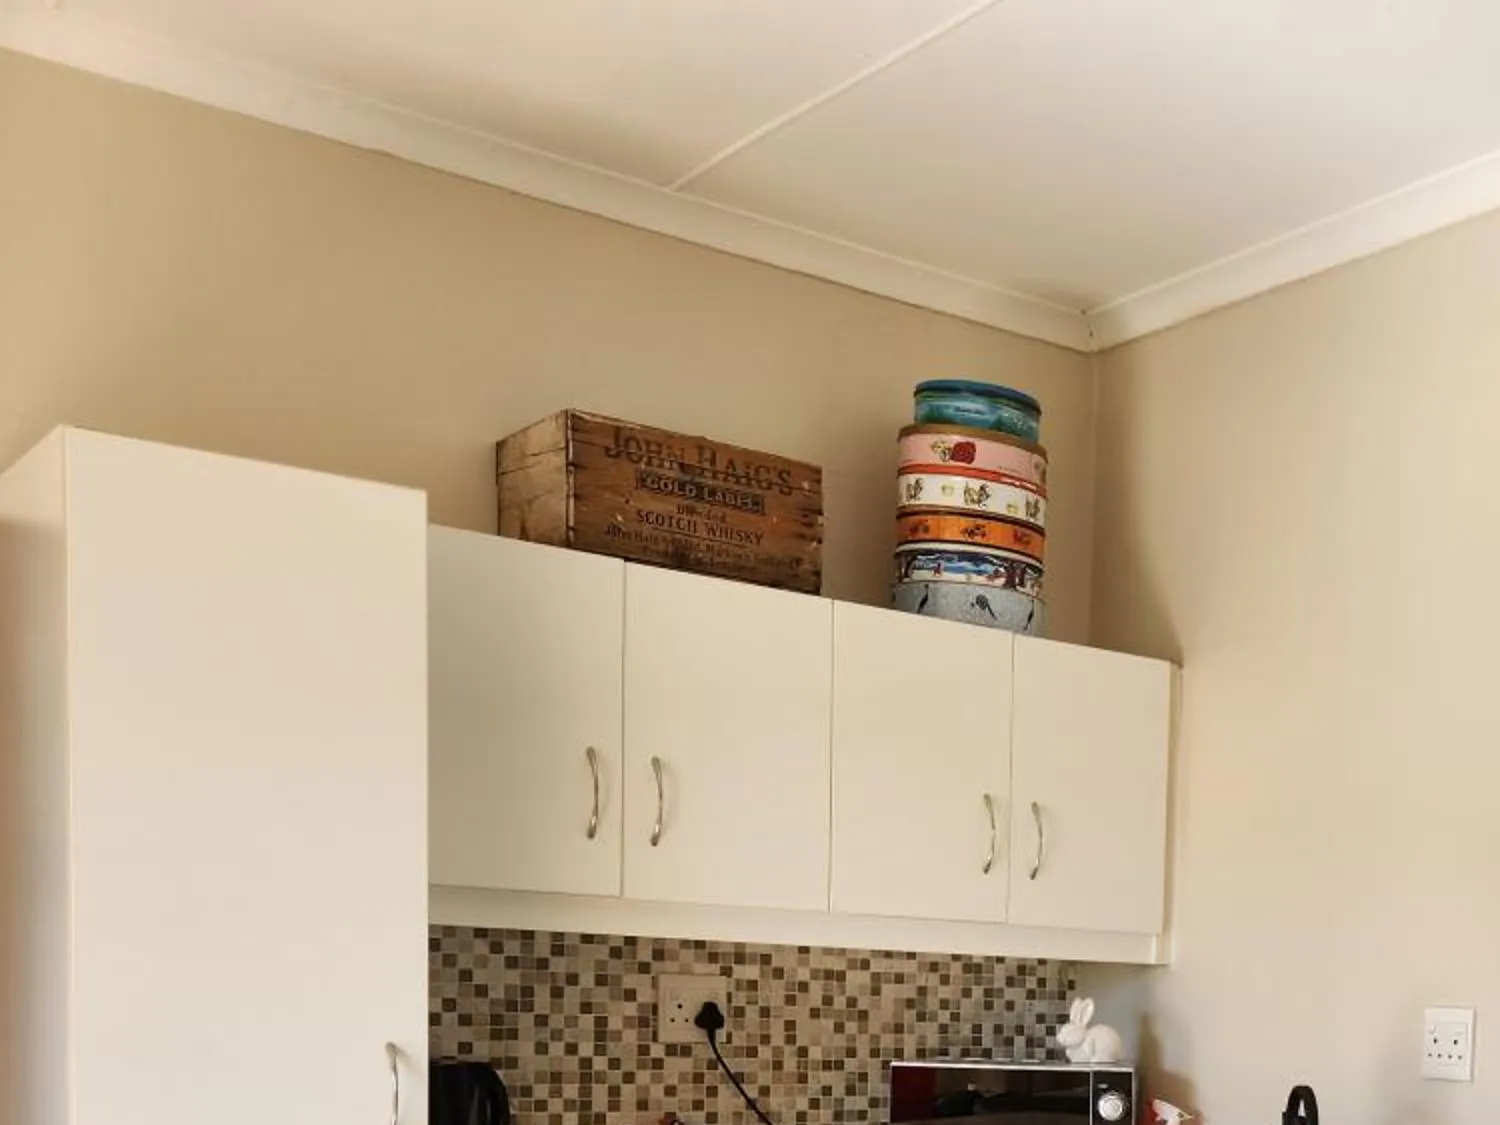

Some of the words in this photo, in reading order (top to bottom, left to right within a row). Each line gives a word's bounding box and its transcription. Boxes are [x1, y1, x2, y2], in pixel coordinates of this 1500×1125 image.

[603, 425, 687, 469] JOHN
[647, 475, 698, 498] GOLD
[637, 509, 698, 536] SCOTCH
[703, 521, 764, 546] WHISKY
